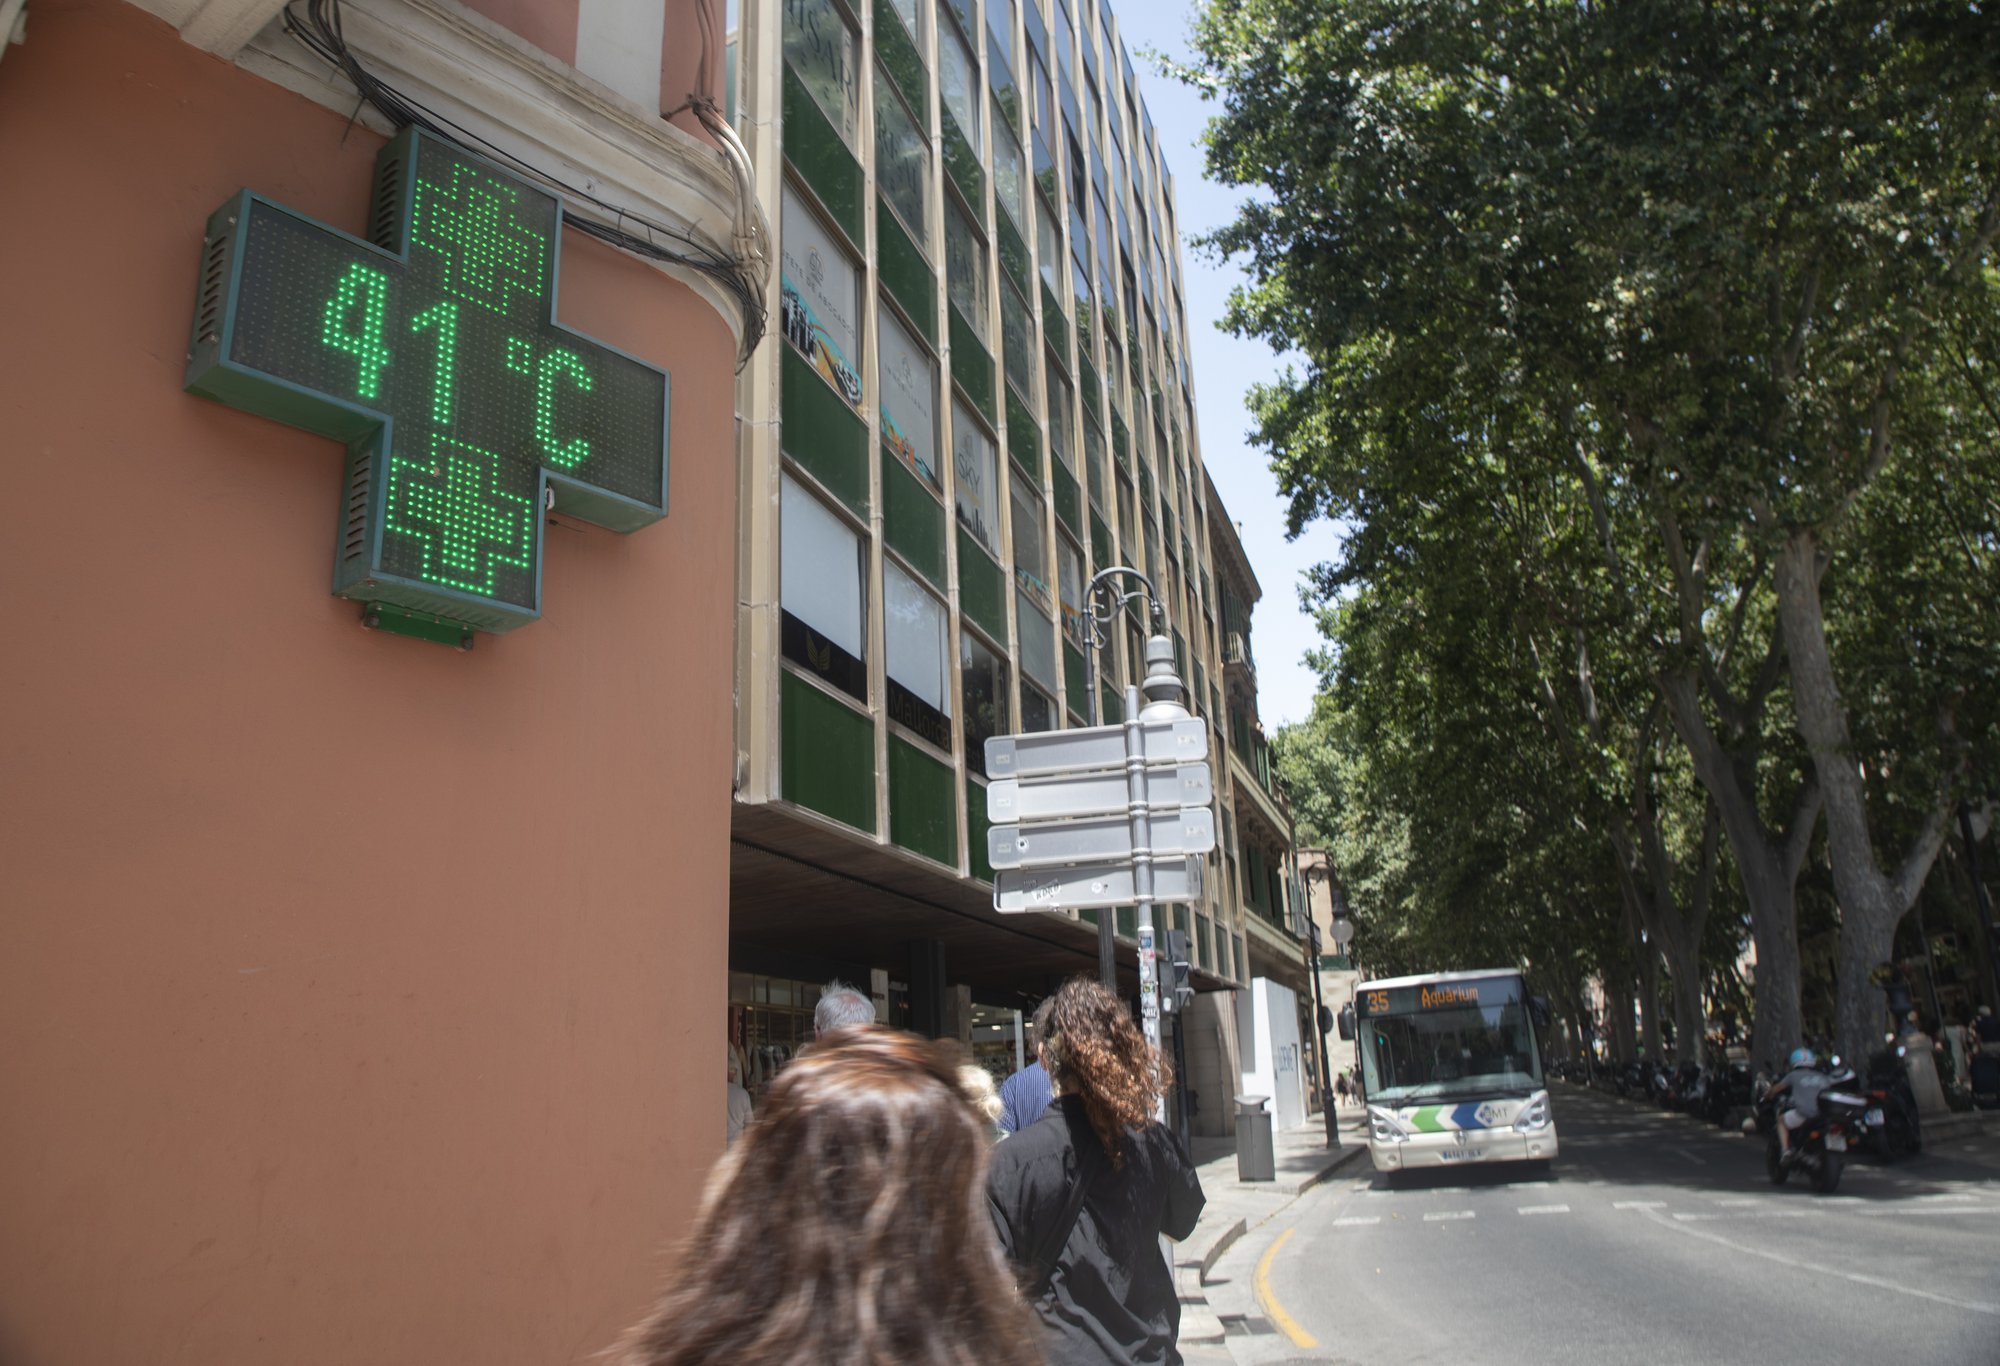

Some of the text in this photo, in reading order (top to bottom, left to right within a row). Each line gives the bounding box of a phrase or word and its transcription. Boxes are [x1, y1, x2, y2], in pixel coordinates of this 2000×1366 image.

[321, 262, 458, 425] 41
[958, 451, 981, 495] SKY
[890, 686, 951, 750] Mallorca
[1367, 991, 1391, 1013] 35
